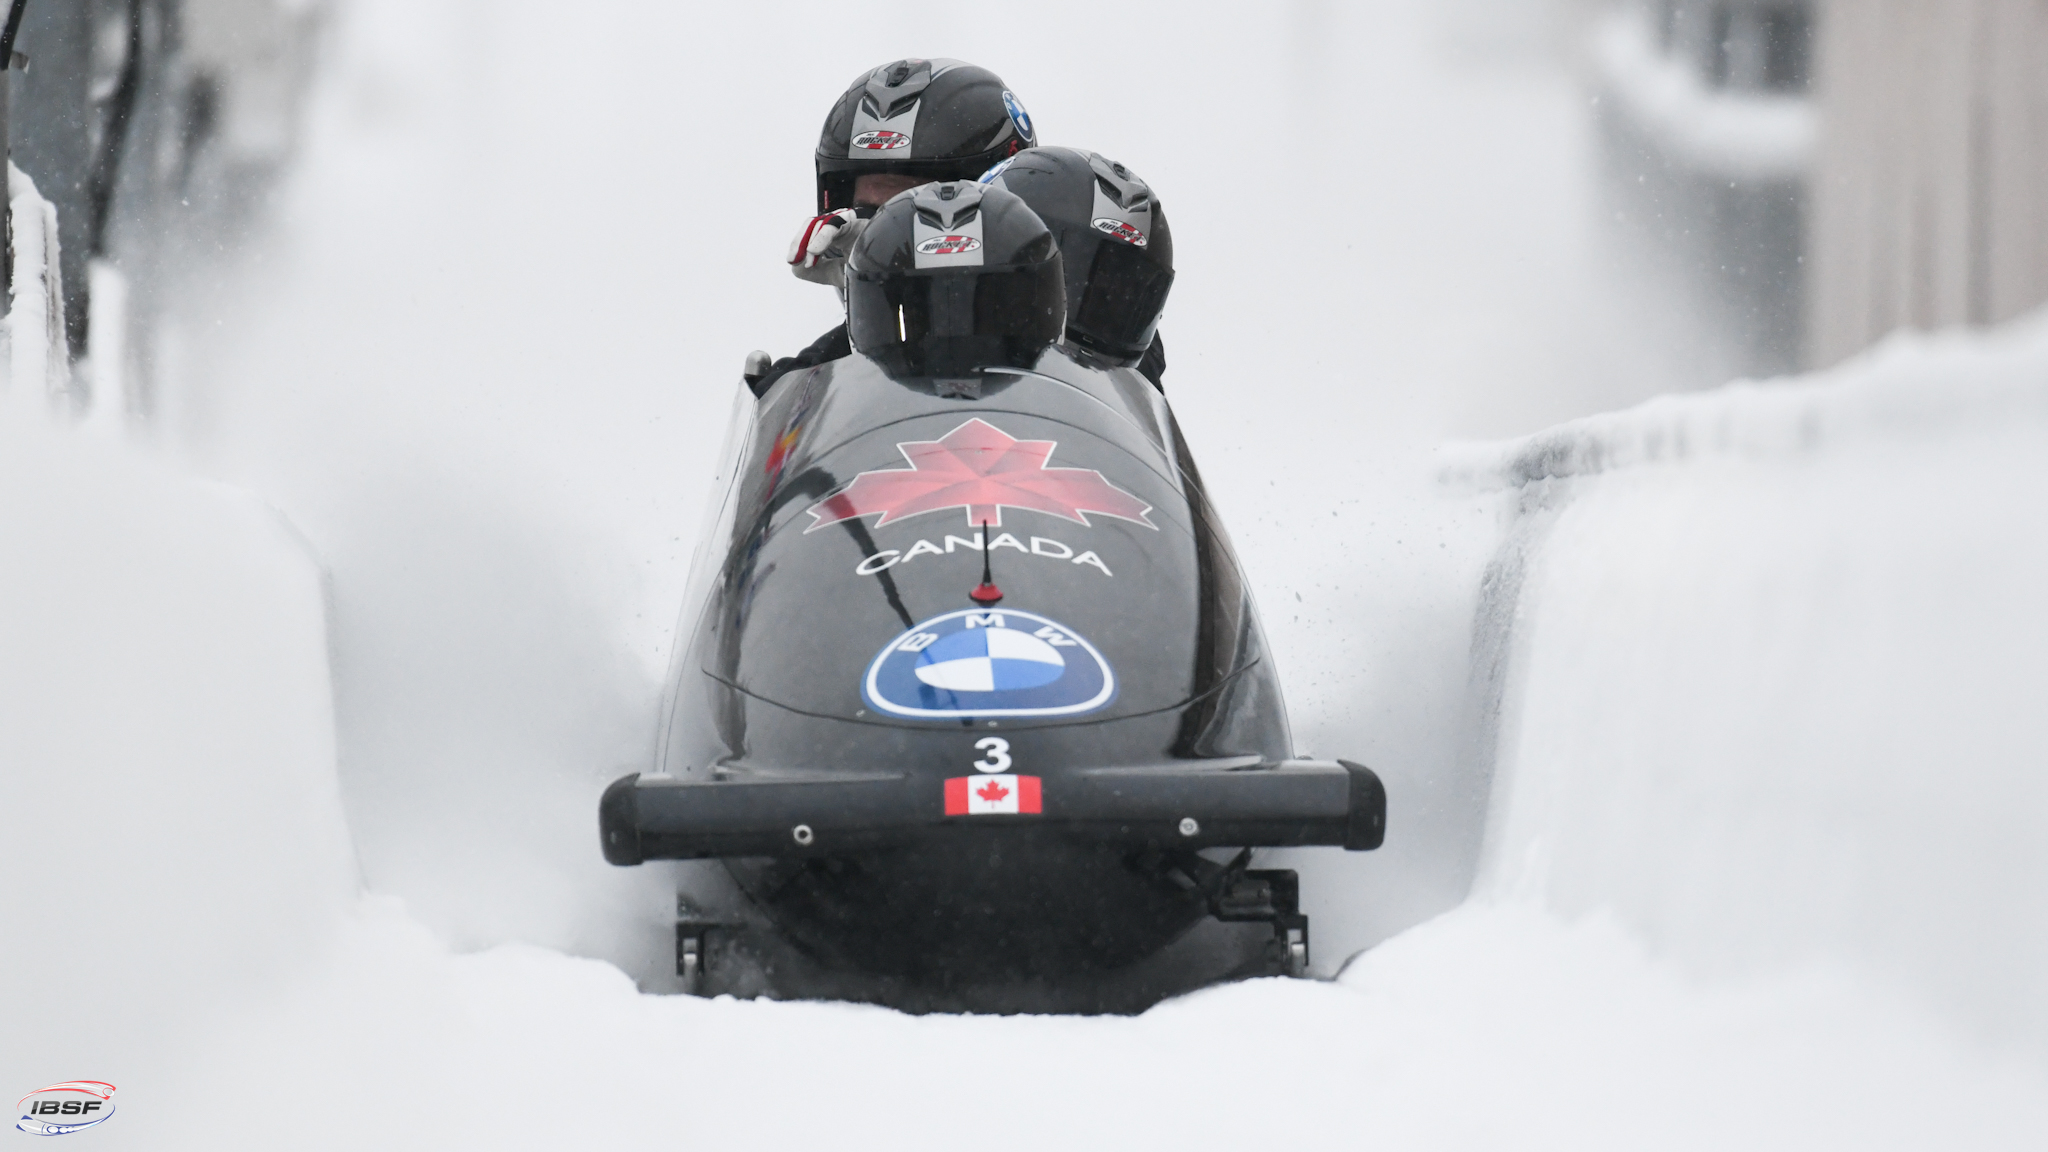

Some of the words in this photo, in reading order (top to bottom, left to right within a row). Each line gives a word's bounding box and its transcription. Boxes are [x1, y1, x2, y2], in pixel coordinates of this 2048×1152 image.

[856, 532, 1113, 577] CANADA
[897, 614, 1078, 652] BMW
[973, 737, 1012, 773] 3
